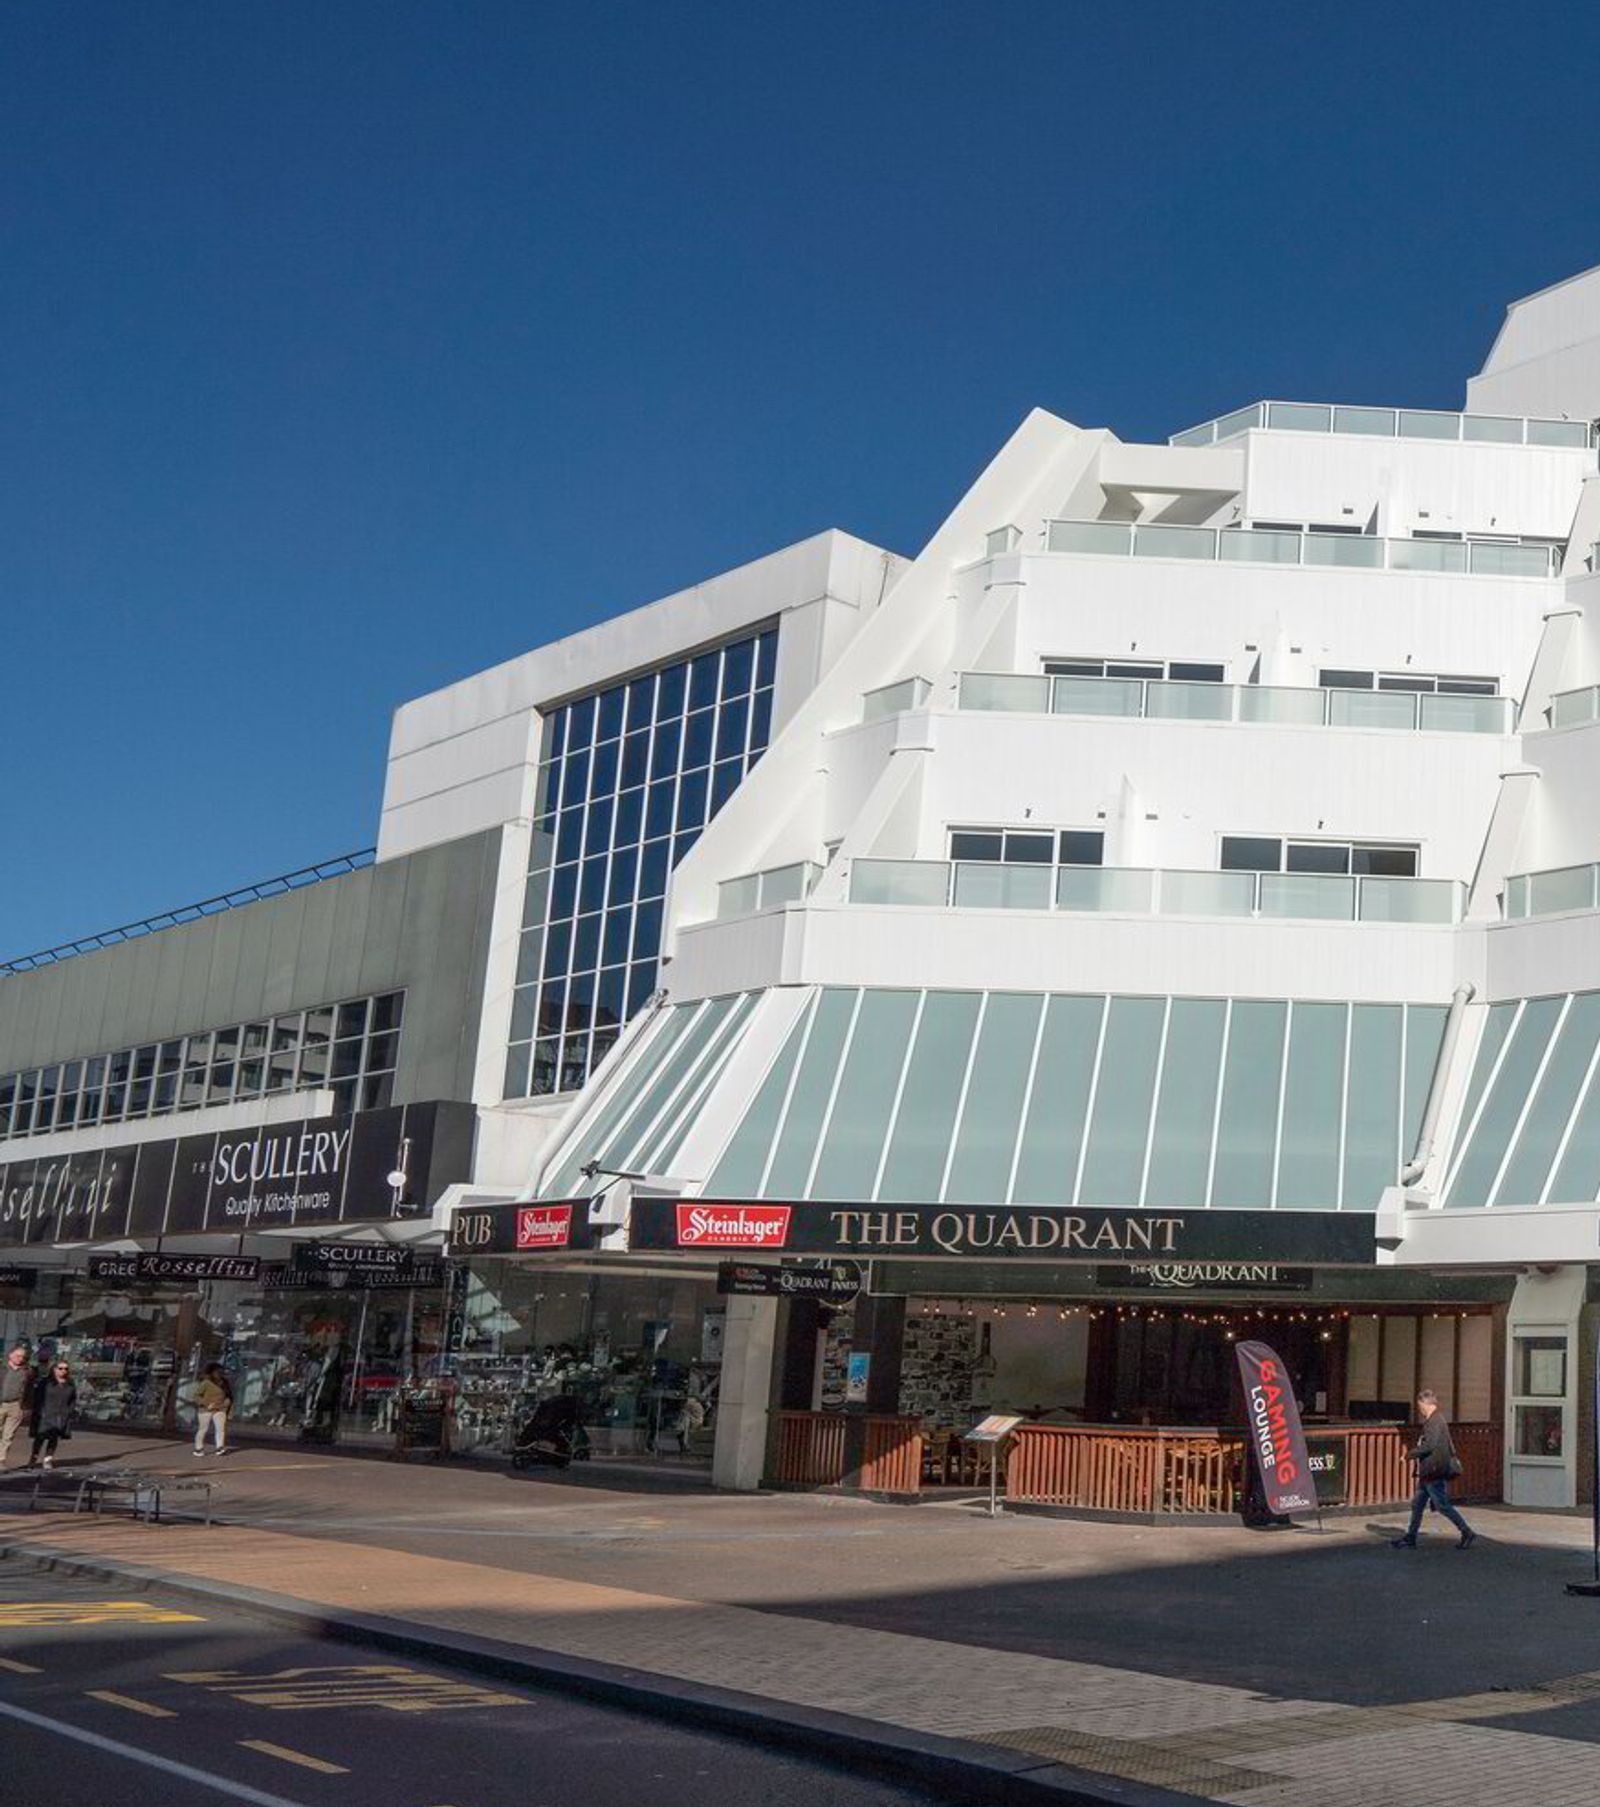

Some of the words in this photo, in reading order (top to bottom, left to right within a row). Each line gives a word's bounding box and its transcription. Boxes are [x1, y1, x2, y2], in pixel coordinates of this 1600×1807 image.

[215, 1129, 349, 1186] SCULLERY
[0, 1162, 117, 1222] sellini
[451, 1214, 491, 1246] PUB
[682, 1208, 785, 1242] Steinlager
[830, 1210, 919, 1246] THE
[931, 1213, 1185, 1254] QUADRANT
[141, 1255, 258, 1277] Rossellini
[318, 1247, 408, 1263] SCULLERY
[1251, 1386, 1275, 1469] LOUNGE
[1260, 1359, 1297, 1485] GAMING
